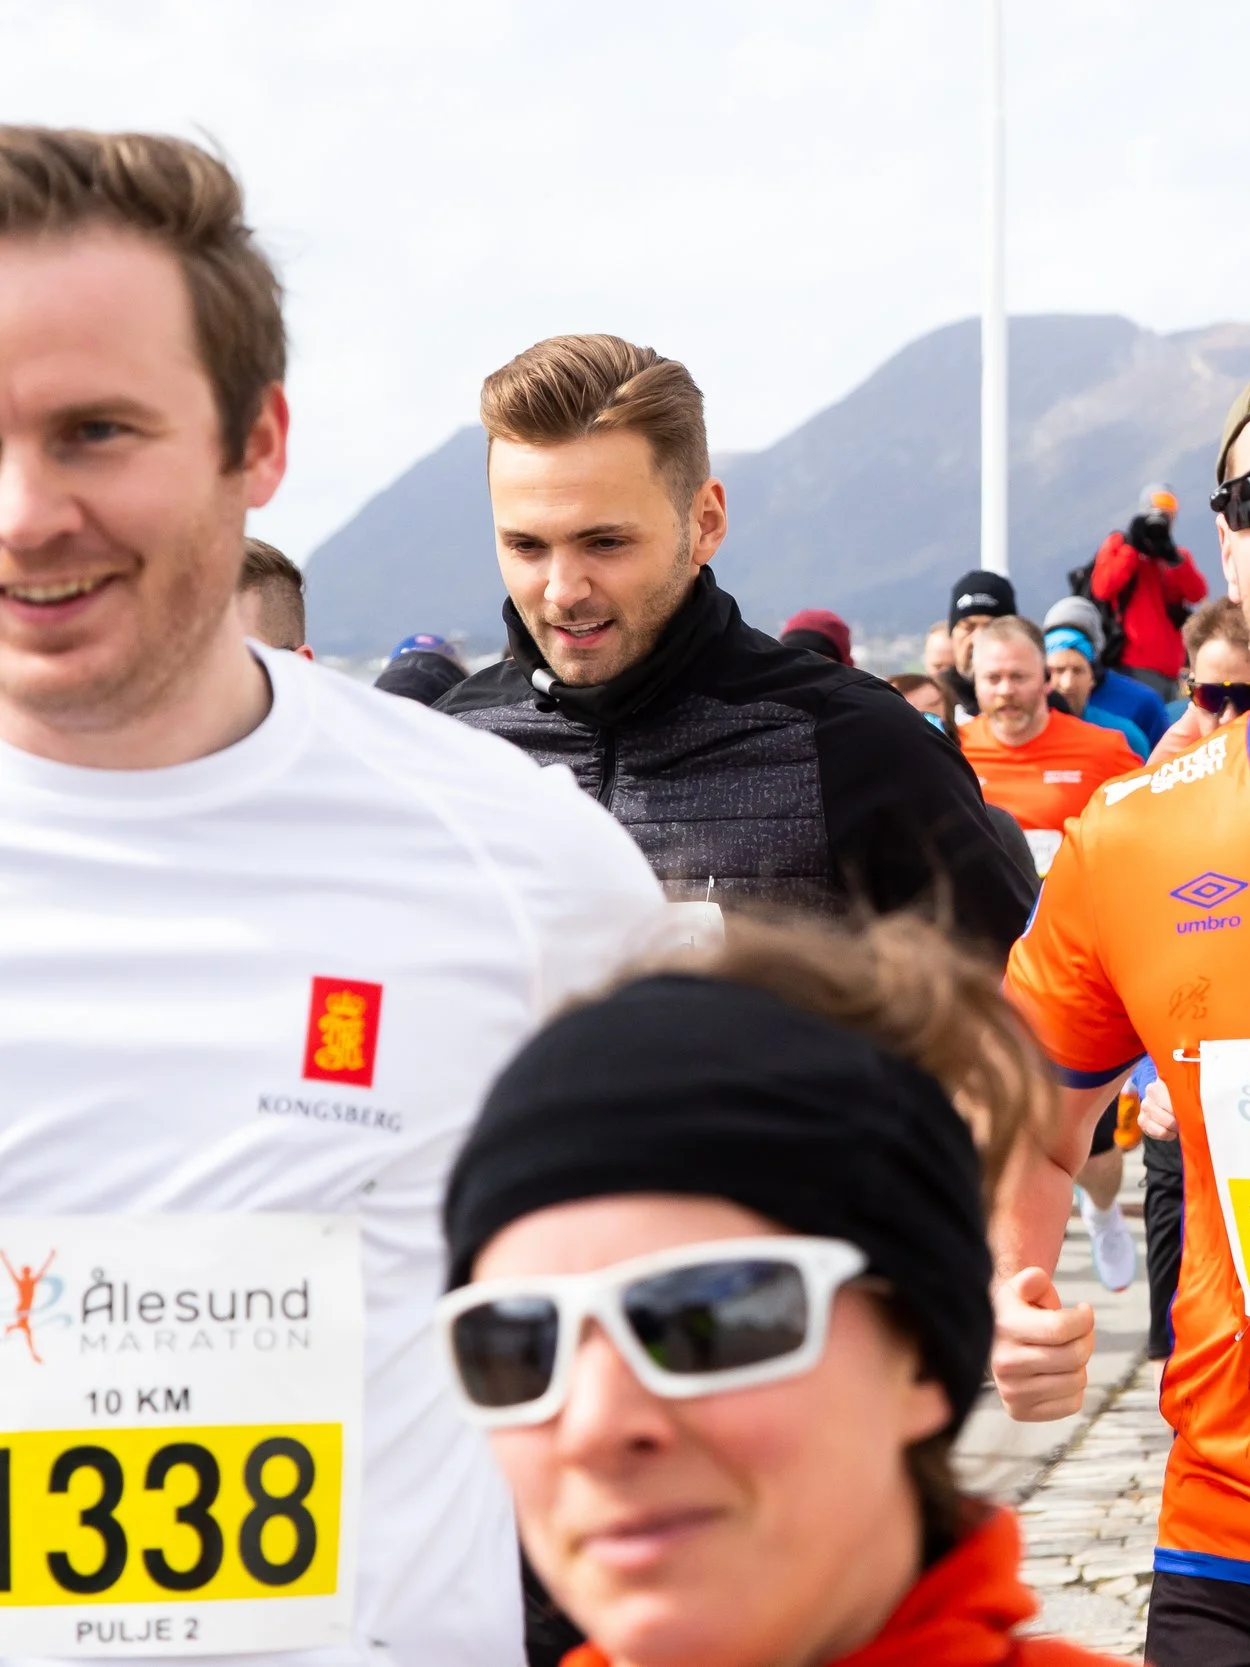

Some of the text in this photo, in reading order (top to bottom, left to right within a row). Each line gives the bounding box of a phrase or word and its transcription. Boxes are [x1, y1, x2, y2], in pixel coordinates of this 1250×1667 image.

[1176, 914, 1242, 934] umbro
[257, 1093, 403, 1133] KONGSBERG
[81, 1266, 311, 1325] Ålesund
[79, 1327, 312, 1355] MARATON
[86, 1387, 192, 1415] 10 KM
[76, 1617, 200, 1644] PULJE 2
